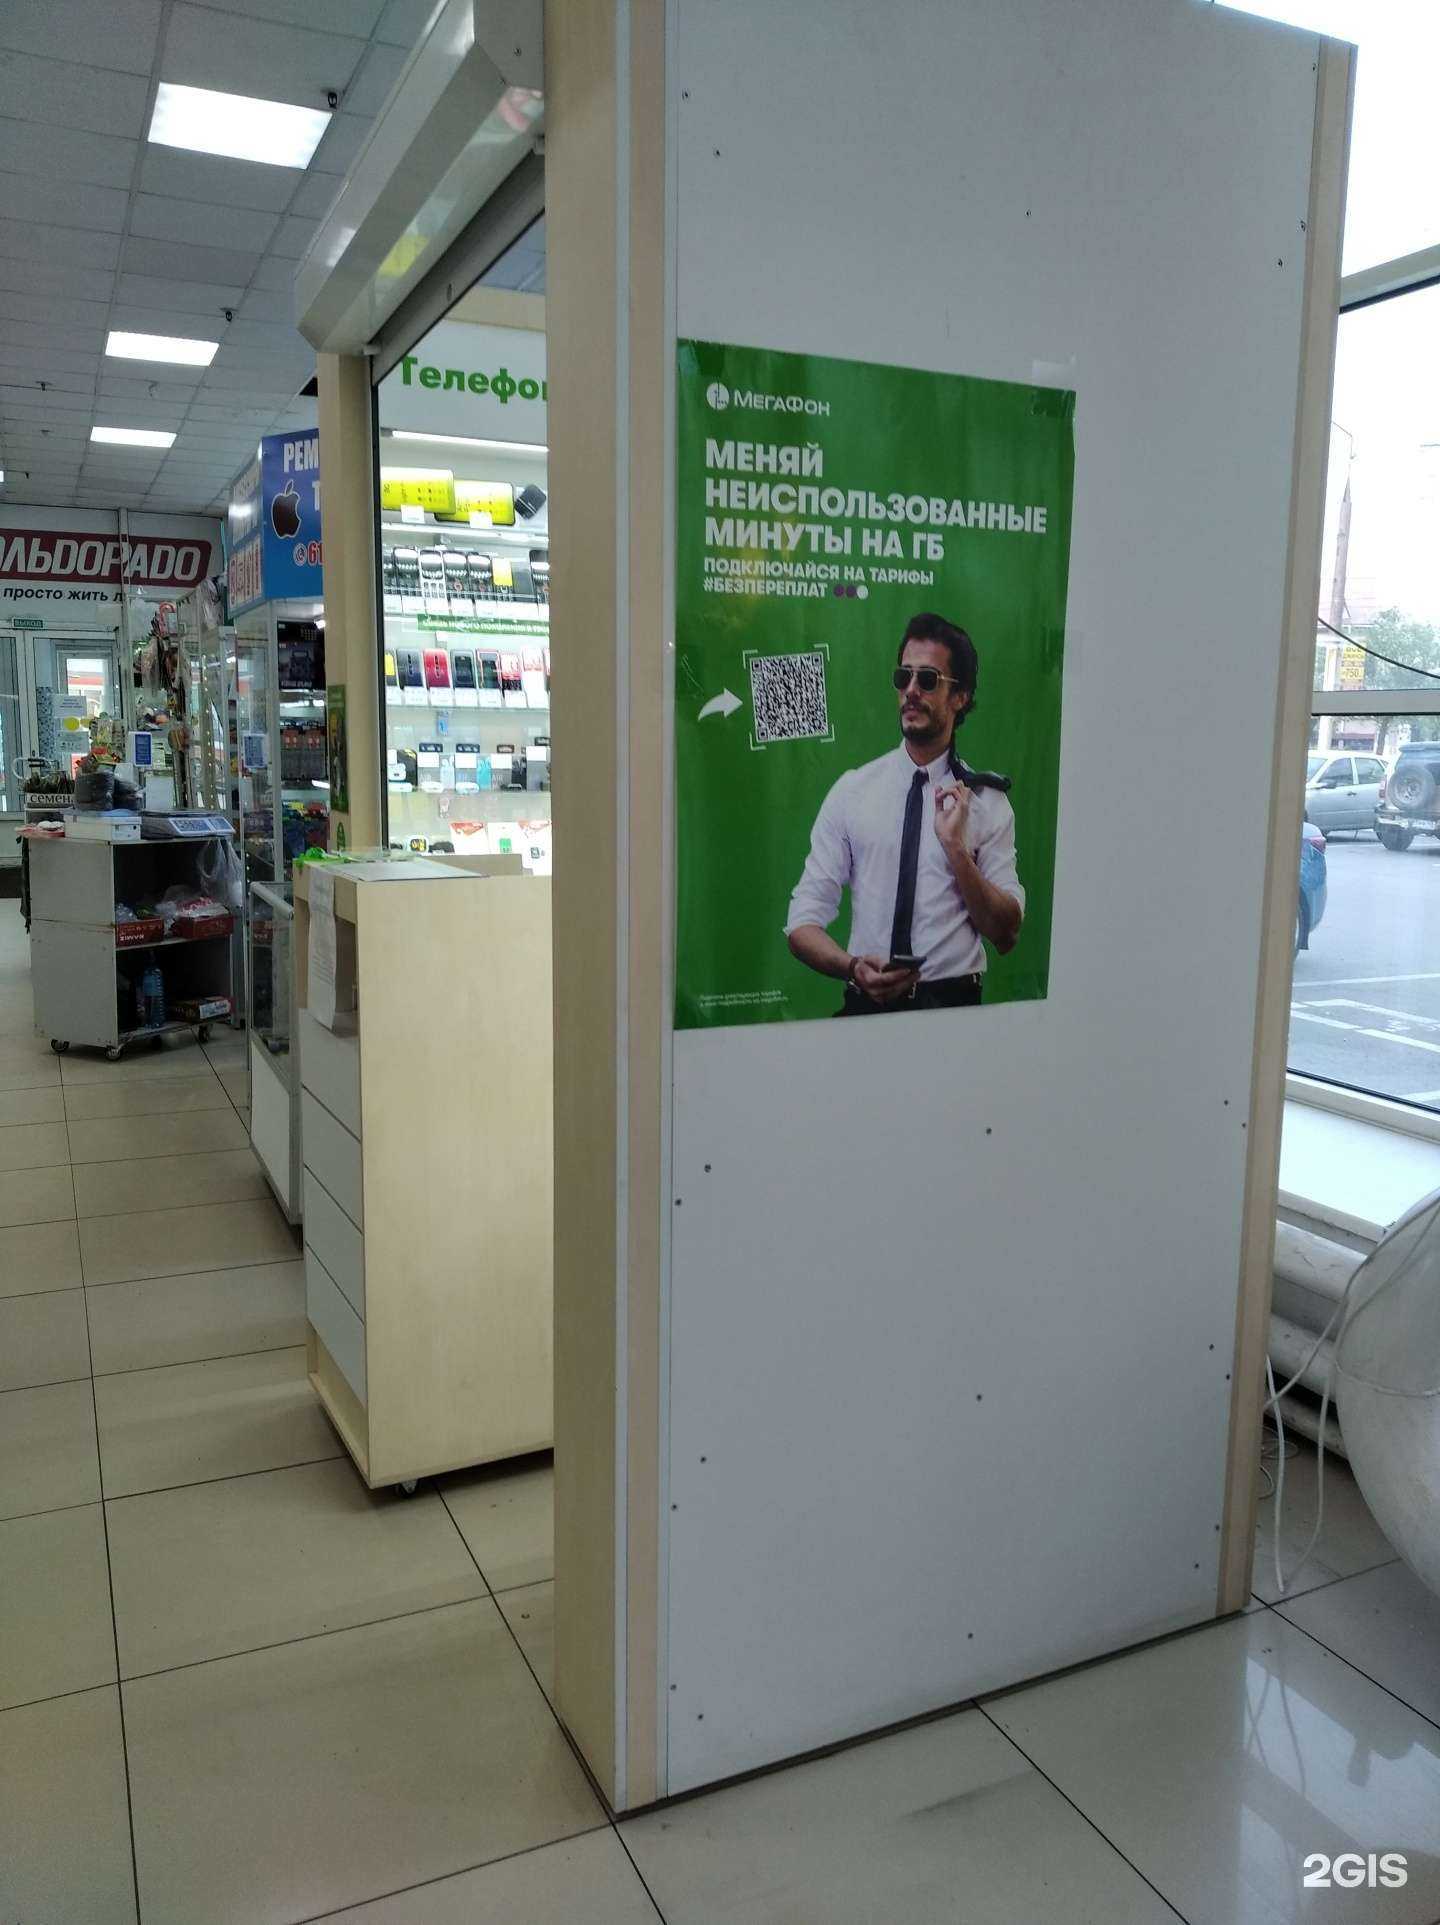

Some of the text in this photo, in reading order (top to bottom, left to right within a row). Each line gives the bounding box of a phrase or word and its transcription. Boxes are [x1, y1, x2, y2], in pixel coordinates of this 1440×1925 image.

[705, 438, 823, 478] МЕНЯЙ
[705, 477, 1048, 534] НЕИСПОЛЬЗОВАННЫЕ
[705, 517, 945, 562] МИНУТЫ НА ГБ
[703, 576, 828, 598] #БЕЗПЕРЕПЛАТ
[704, 557, 934, 585] ПОДКЛЮЧАЙСЯ НА ТАРИФЫ
[3, 587, 63, 604] просто
[67, 589, 109, 602] жить
